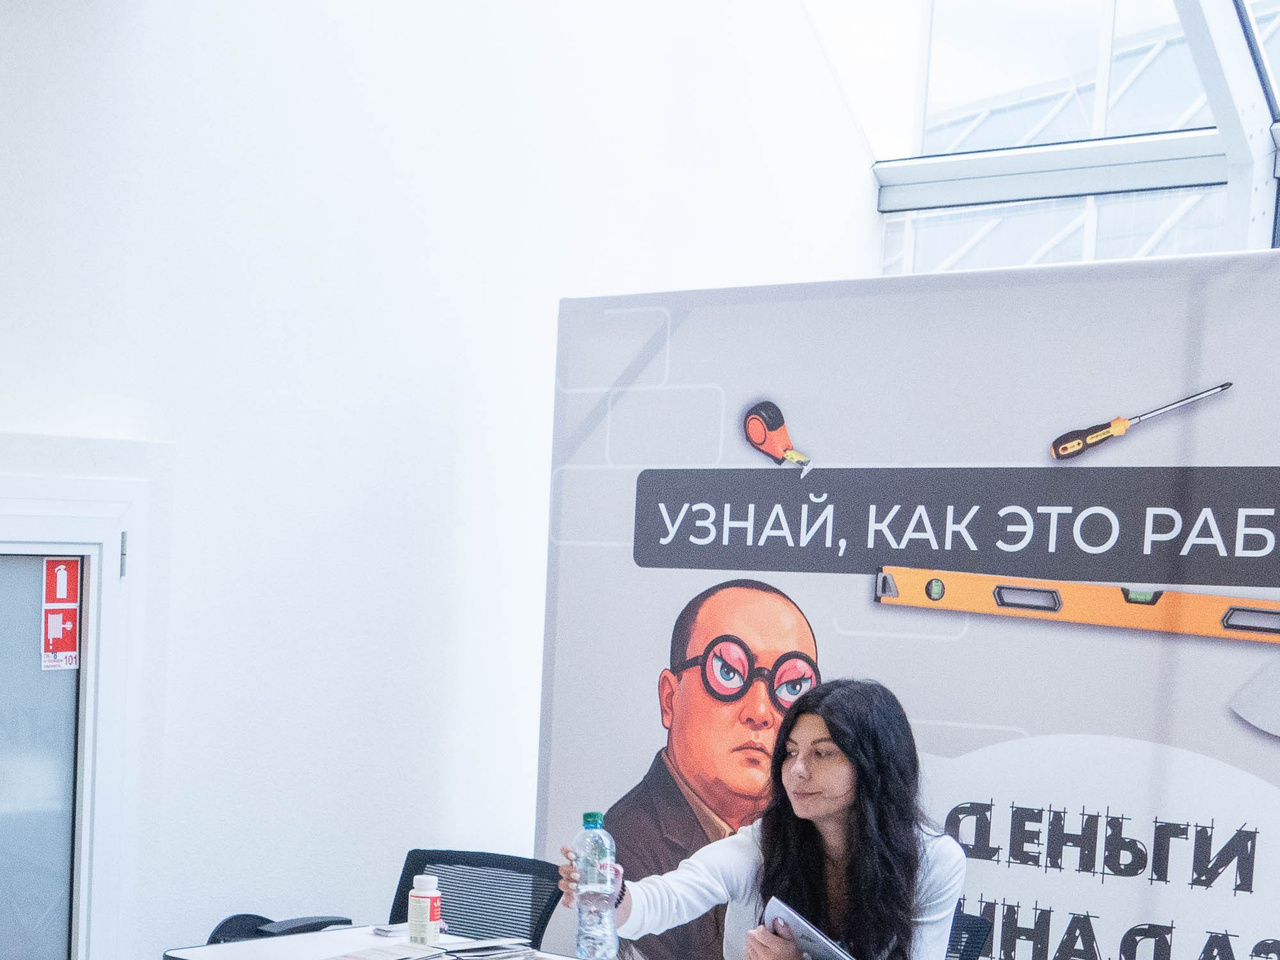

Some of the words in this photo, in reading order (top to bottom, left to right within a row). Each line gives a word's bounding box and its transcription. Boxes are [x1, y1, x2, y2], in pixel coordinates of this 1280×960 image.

[657, 492, 848, 557] УЗНАЙ,
[867, 505, 979, 552] КАК
[994, 505, 1120, 555] ЭТО
[64, 655, 78, 666] 101
[945, 798, 1258, 897] ДЕНЬГИ
